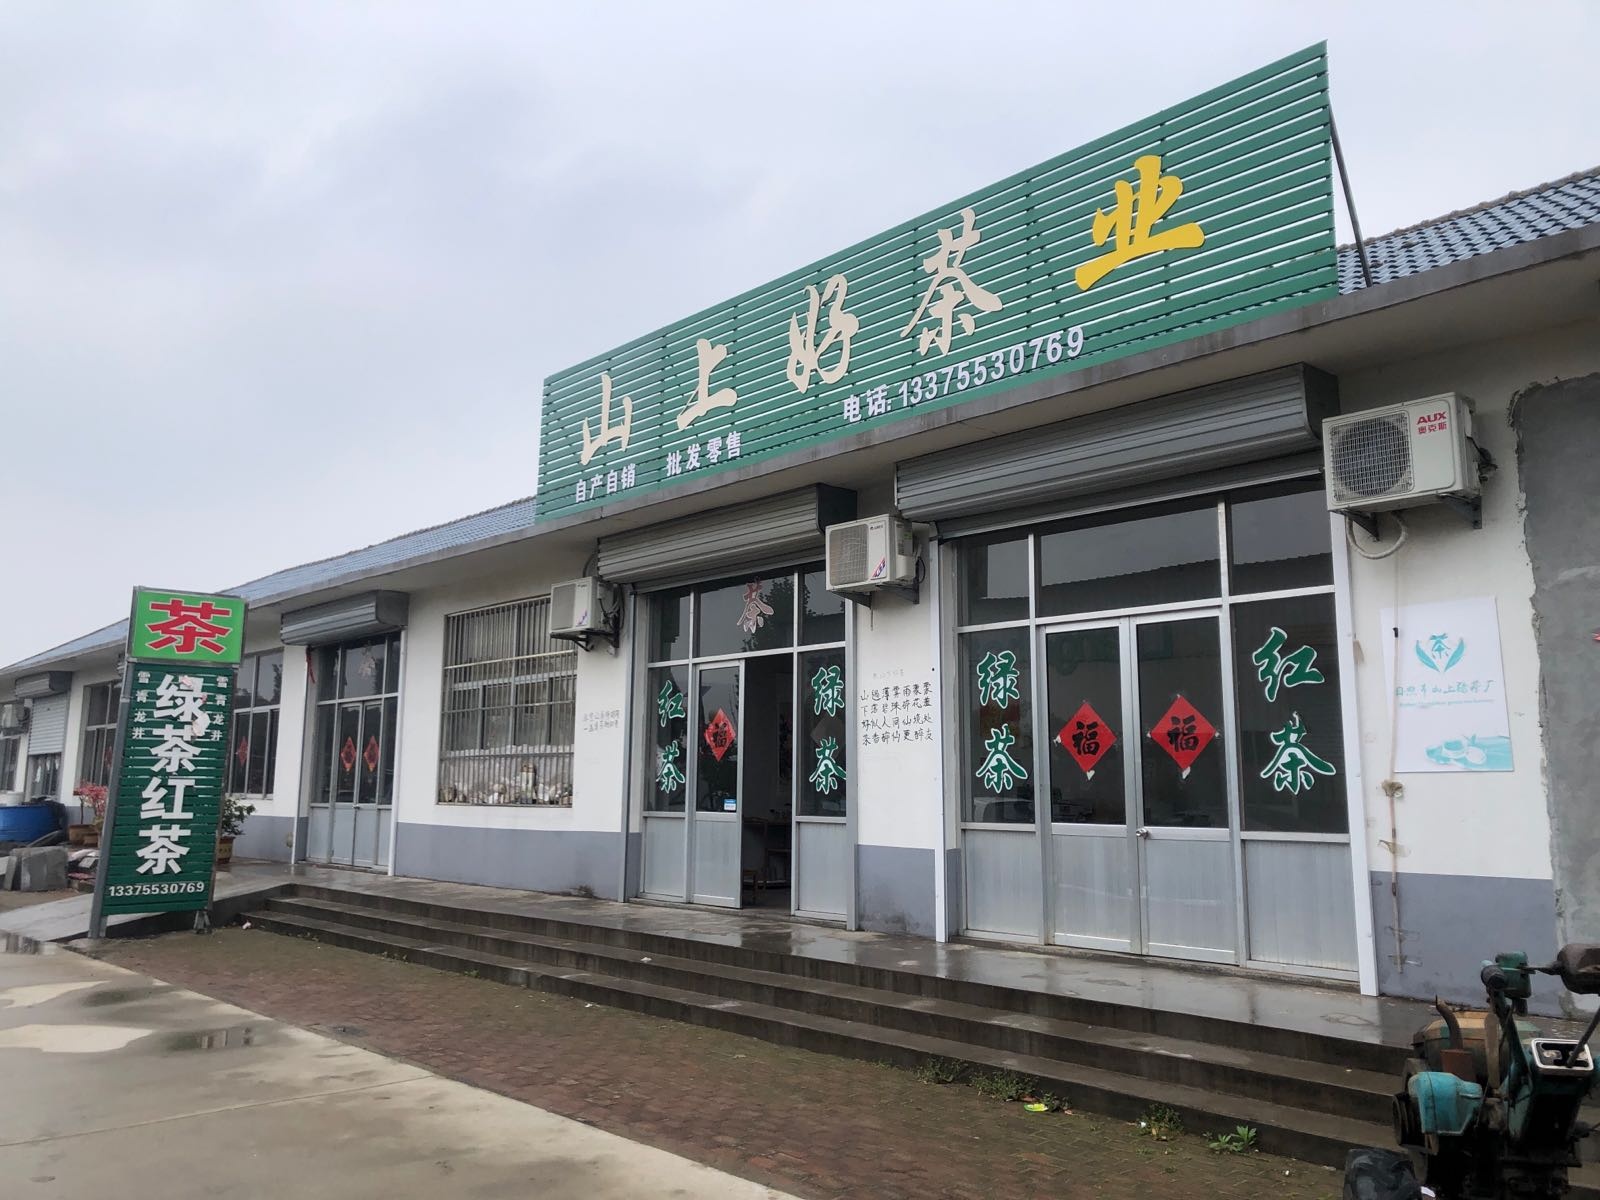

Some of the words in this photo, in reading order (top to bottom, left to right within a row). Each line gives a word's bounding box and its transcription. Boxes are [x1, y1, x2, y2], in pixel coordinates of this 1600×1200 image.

[580, 155, 1204, 466] 山上好茶业
[898, 326, 1085, 407] 13375530769
[1417, 411, 1447, 425] AUX
[1418, 422, 1447, 435] 奥克斯
[575, 464, 636, 503] 自产自销
[667, 431, 742, 477] 批发零售
[146, 598, 232, 655] 茶
[737, 577, 774, 633] 茶
[656, 680, 686, 793] 红茶
[808, 665, 847, 794] 绿茶
[976, 650, 1028, 793] 绿茶
[1072, 721, 1100, 756] 福
[1167, 715, 1199, 752] 福
[1254, 627, 1336, 795] 红茶
[135, 673, 206, 875] 绿茶红茶
[109, 881, 205, 897] 13375530769
